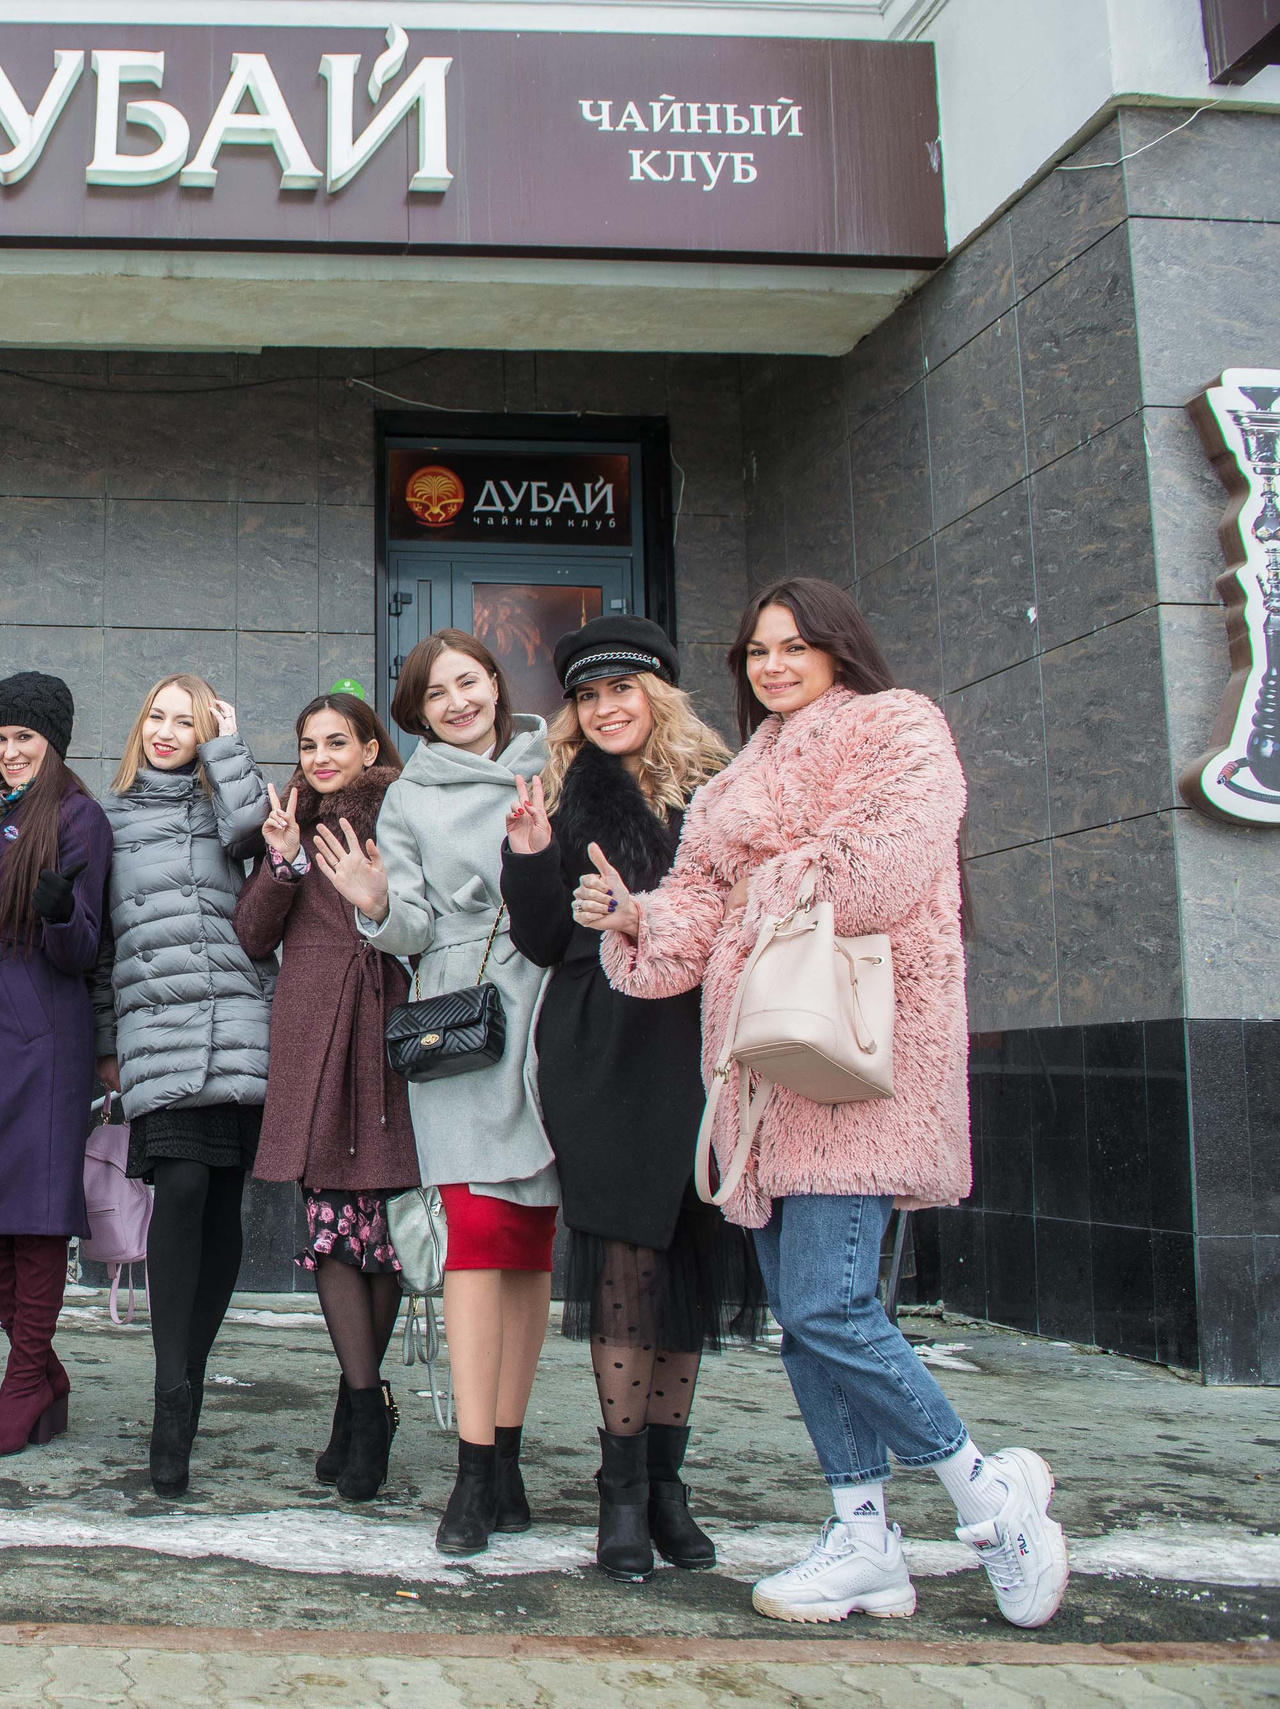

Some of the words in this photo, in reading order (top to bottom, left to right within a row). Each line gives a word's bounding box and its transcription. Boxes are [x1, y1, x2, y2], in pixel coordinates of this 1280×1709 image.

[578, 93, 804, 136] ЧАЙНЫЙ
[628, 149, 758, 191] КЛУБ
[473, 475, 615, 515] ДУБАЙ
[473, 516, 553, 527] чайный
[568, 518, 616, 530] клуб
